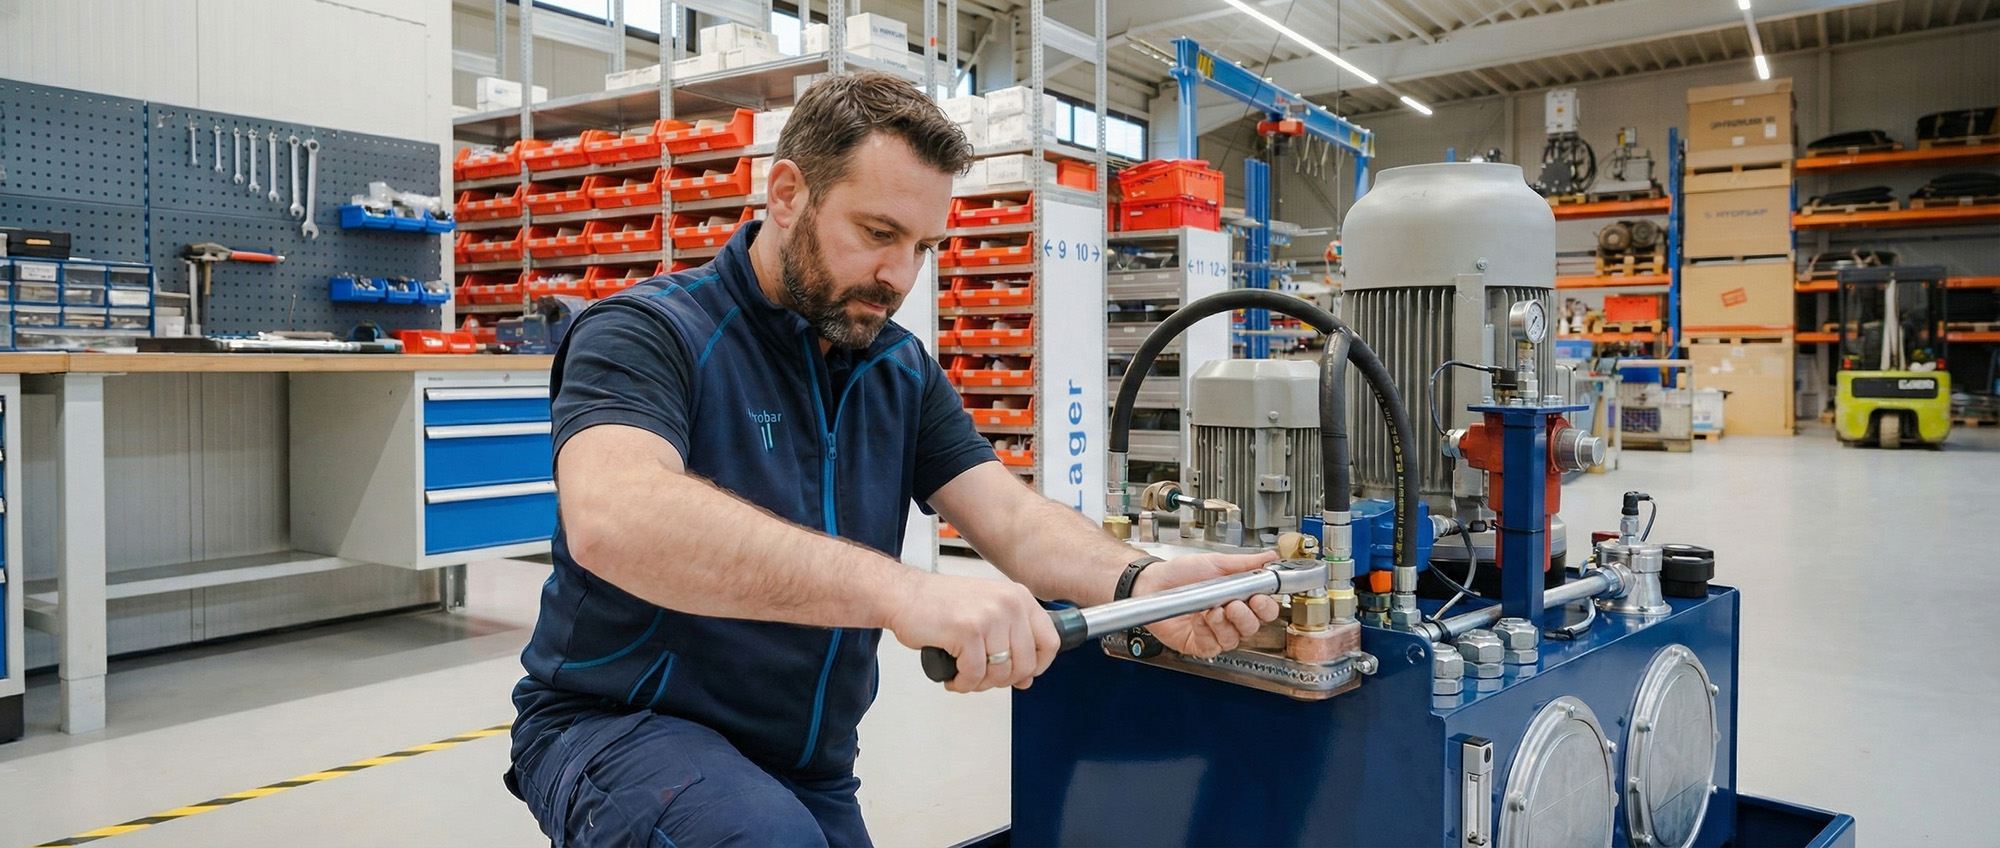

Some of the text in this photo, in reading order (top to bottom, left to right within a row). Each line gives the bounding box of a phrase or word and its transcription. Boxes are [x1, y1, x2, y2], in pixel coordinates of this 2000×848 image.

[1058, 239, 1088, 262] 9 10
[1196, 260, 1220, 277] 11 12
